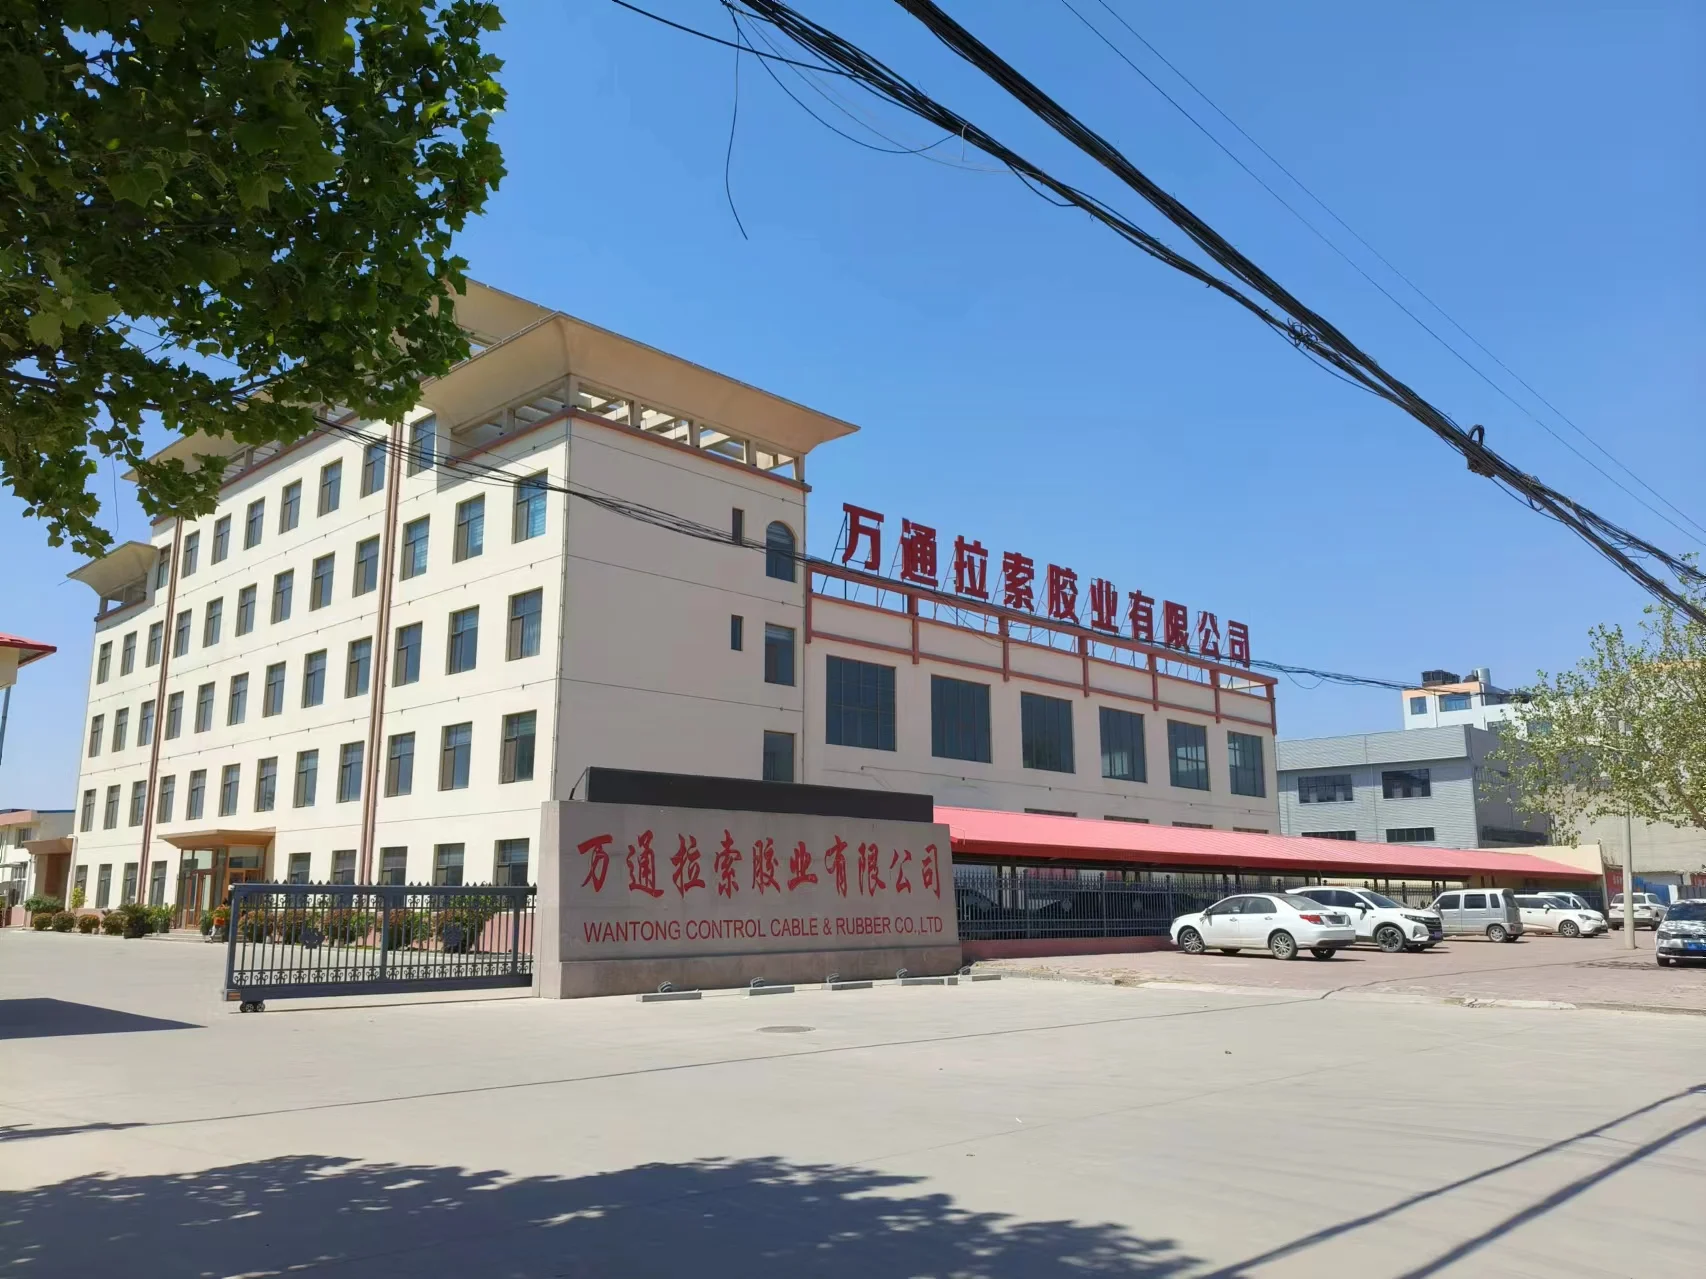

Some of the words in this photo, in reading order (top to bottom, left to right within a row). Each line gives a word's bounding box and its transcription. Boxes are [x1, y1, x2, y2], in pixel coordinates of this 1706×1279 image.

[842, 502, 1250, 669] 万通拉索胶业有限公司
[577, 829, 941, 899] 万通拉索胶业有限公司
[583, 920, 681, 943] WANTONG
[685, 919, 767, 940] CONTROL
[770, 919, 819, 937] CABLE
[823, 920, 833, 936] &
[836, 917, 892, 936] RUBBER
